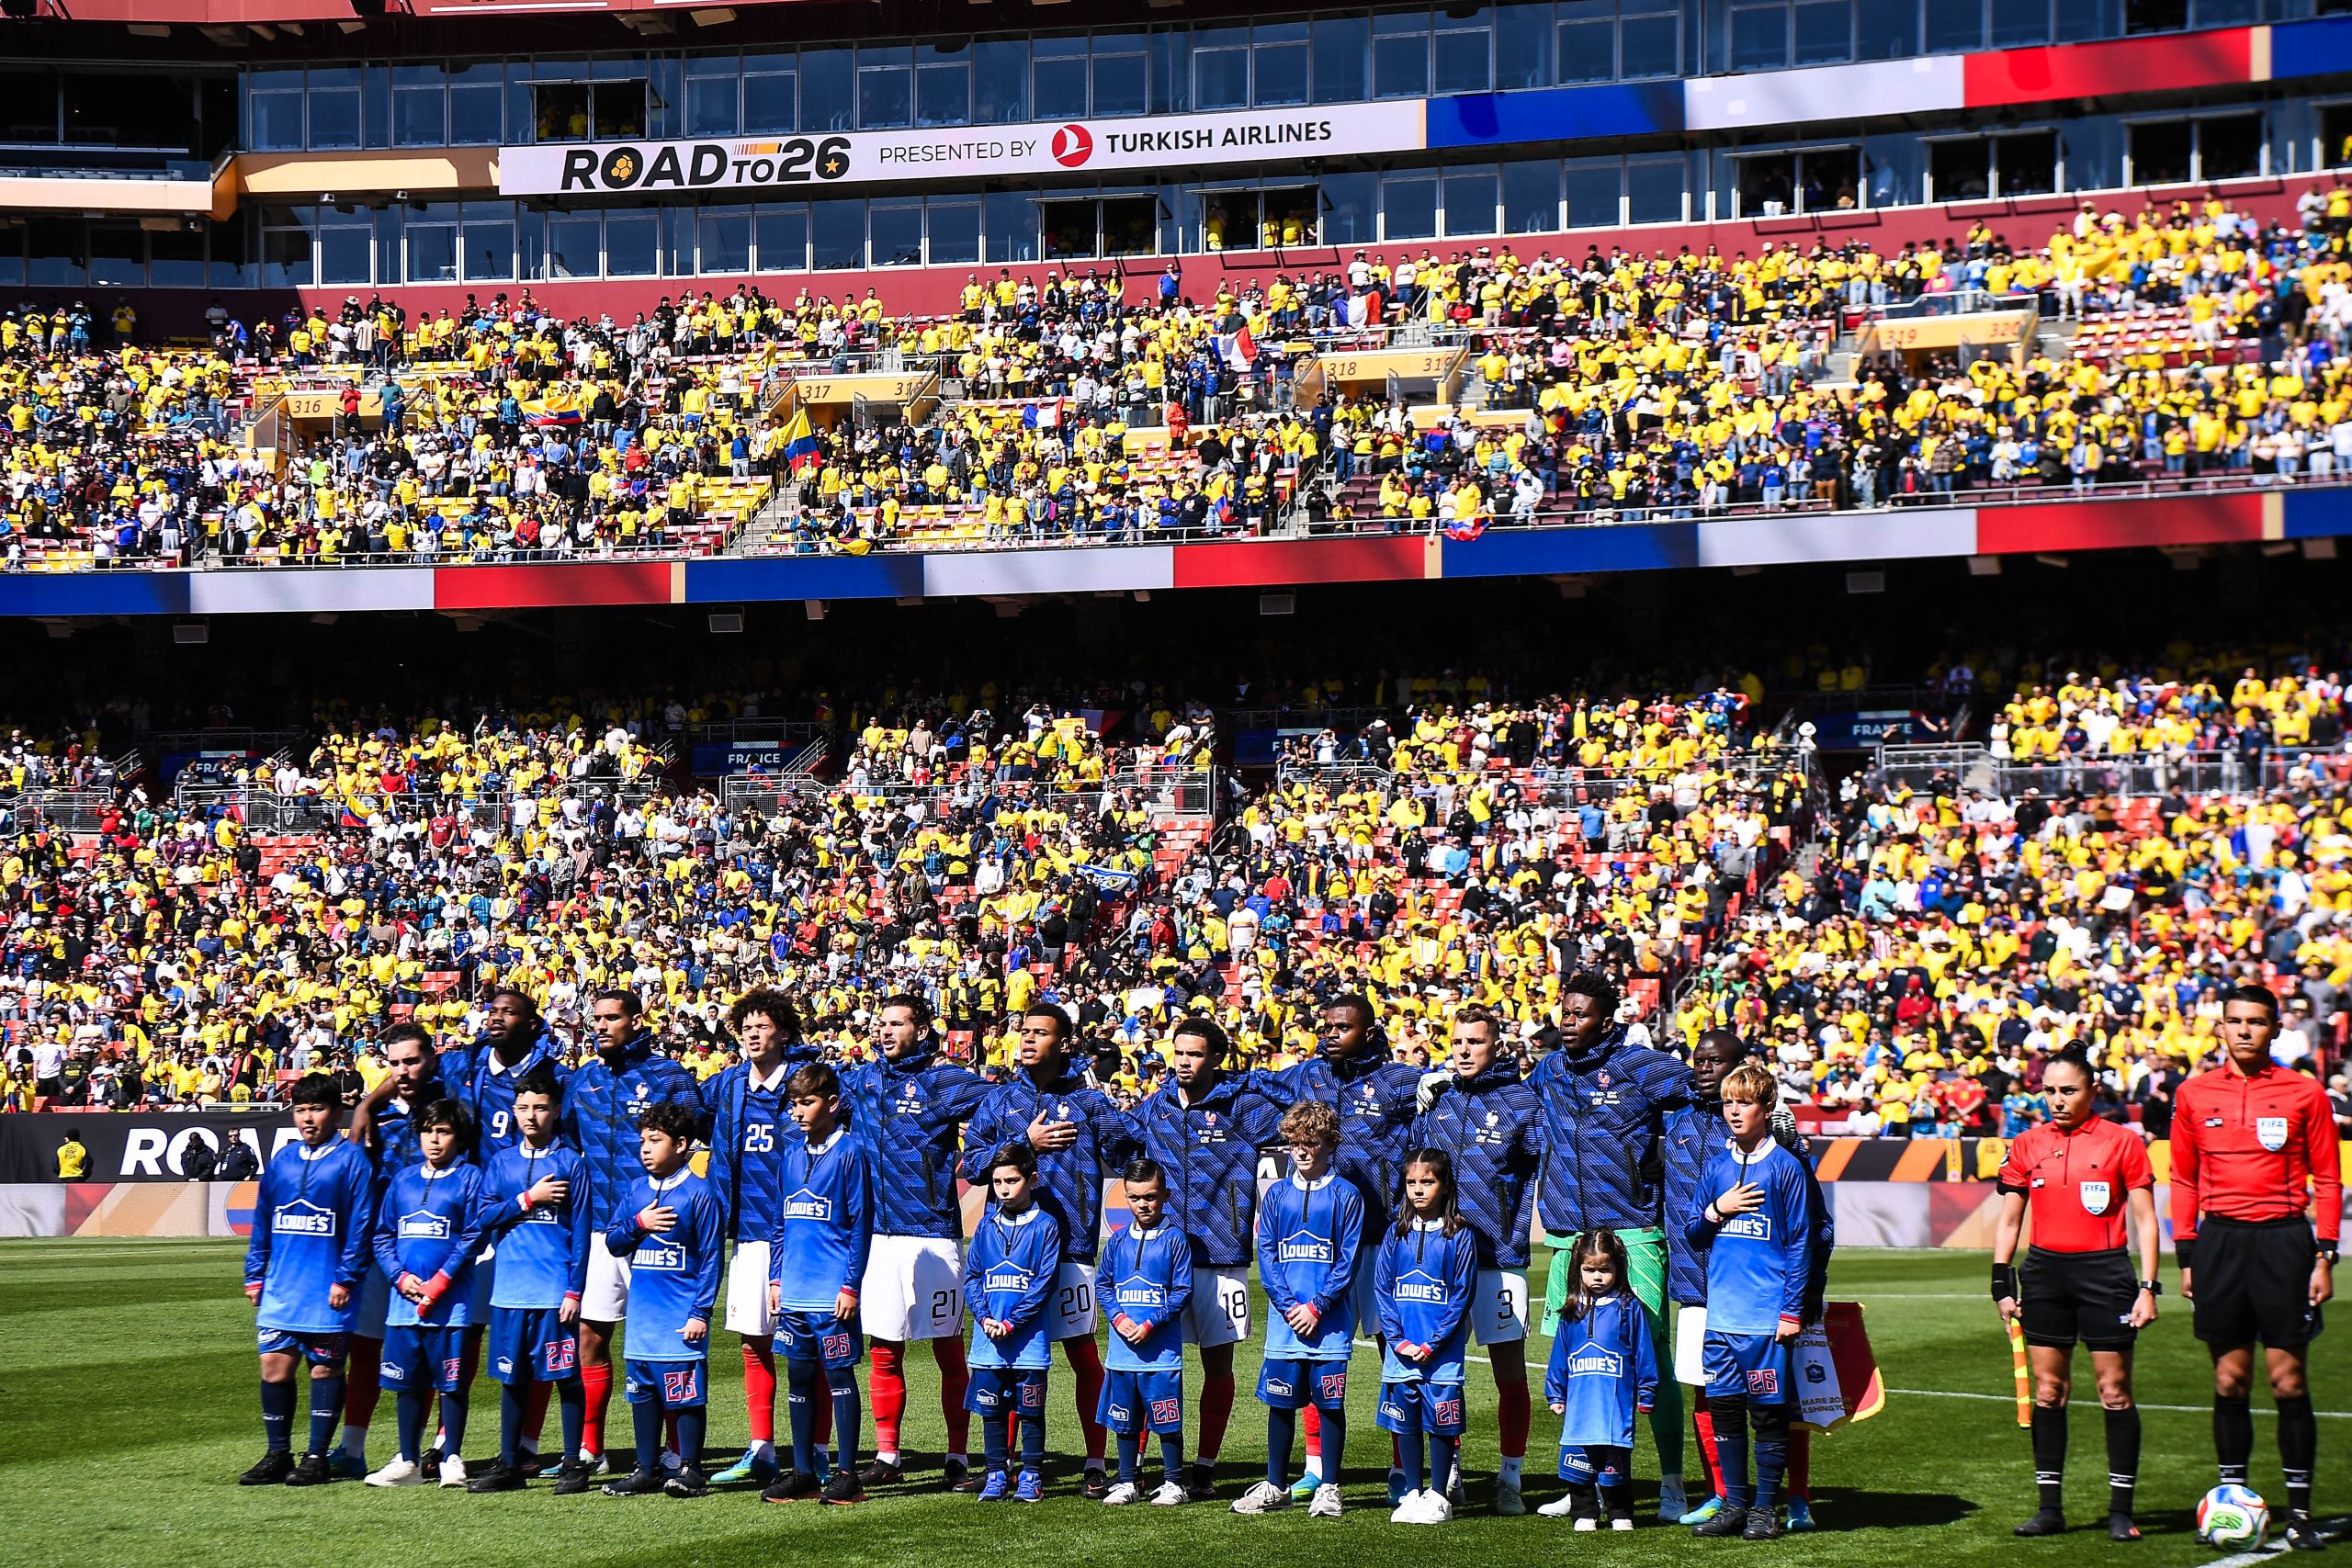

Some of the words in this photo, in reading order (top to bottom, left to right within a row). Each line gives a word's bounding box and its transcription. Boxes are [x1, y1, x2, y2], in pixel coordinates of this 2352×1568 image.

[560, 144, 728, 191] ROAD
[731, 158, 775, 184] TO
[777, 137, 852, 183] 26
[879, 141, 1004, 164] PRESENTED
[1011, 140, 1037, 157] BY
[1106, 130, 1213, 153] TURKISH
[1221, 120, 1332, 147] AIRLINES
[1329, 361, 1358, 377] 318
[804, 384, 831, 399] 317
[293, 400, 322, 414] 316
[1852, 722, 1914, 736] FRAE
[491, 1110, 509, 1138] 9
[744, 1123, 775, 1153] 25
[2085, 1184, 2107, 1192] FIFA
[786, 1201, 825, 1217] LOWE'S
[275, 1211, 331, 1233] LOWE'S
[402, 1220, 445, 1236] LOWE'S
[632, 1247, 678, 1267] OWE'S
[1283, 1243, 1329, 1259] LOWE'S
[986, 1273, 1029, 1290] LOWE'S
[1396, 1281, 1442, 1301] LOWE'S
[932, 1288, 956, 1319] 21
[1059, 1283, 1091, 1318] 20
[1116, 1287, 1161, 1304] LOWE'S
[1222, 1289, 1248, 1322] 18
[1497, 1289, 1514, 1320] 3
[545, 1337, 576, 1372] 26
[823, 1332, 852, 1359] 26
[1572, 1356, 1617, 1373] LOWE'S
[664, 1370, 698, 1403] 26
[1747, 1368, 1778, 1394] 26
[1023, 1382, 1046, 1407] 26
[1802, 1397, 1827, 1406] MARS
[1151, 1397, 1180, 1425] 26
